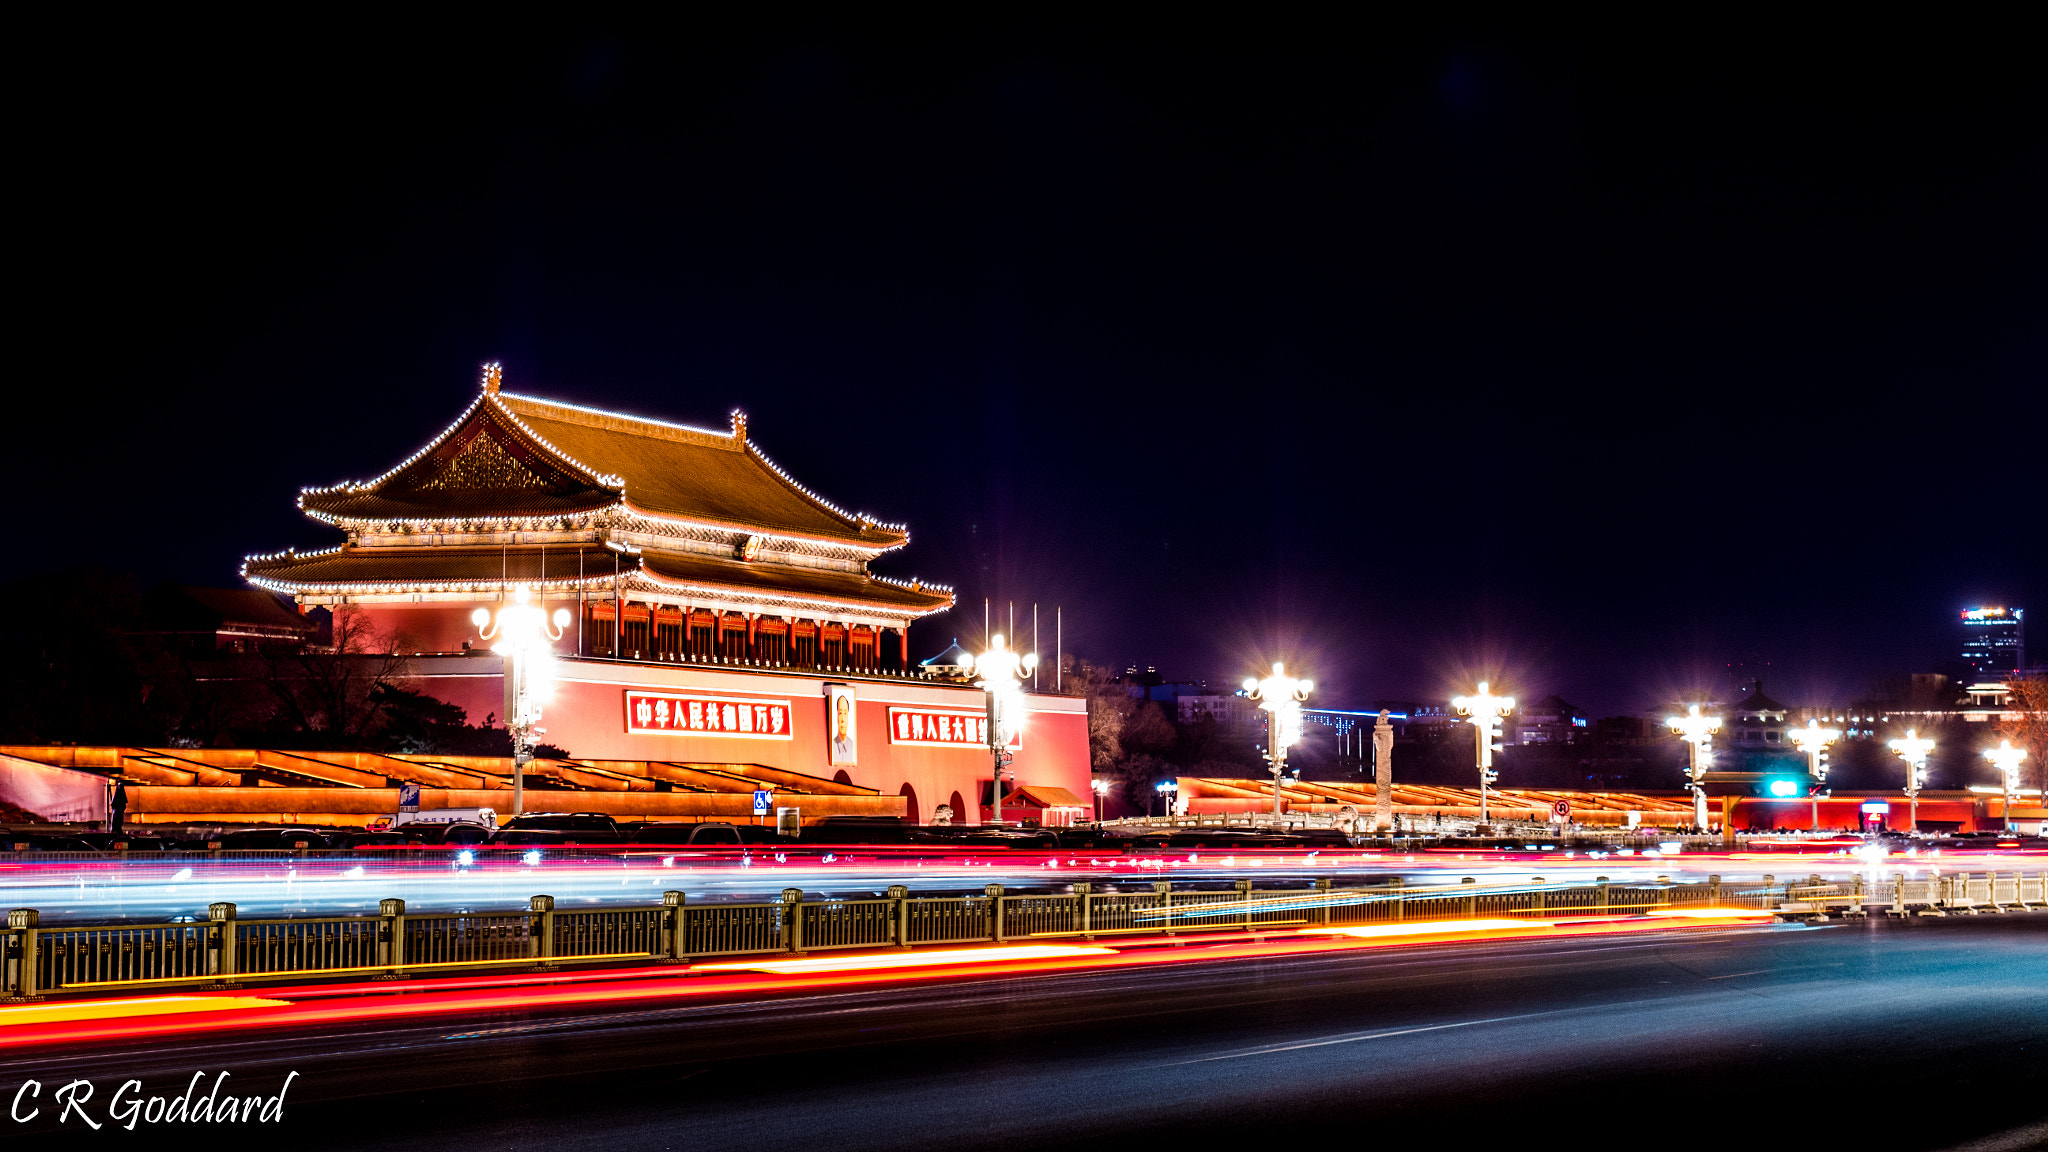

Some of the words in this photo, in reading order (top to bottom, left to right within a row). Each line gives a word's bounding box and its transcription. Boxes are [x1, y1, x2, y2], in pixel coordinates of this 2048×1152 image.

[636, 698, 784, 733] 中华人民共和国万岁
[898, 713, 988, 744] 世界人民大团结
